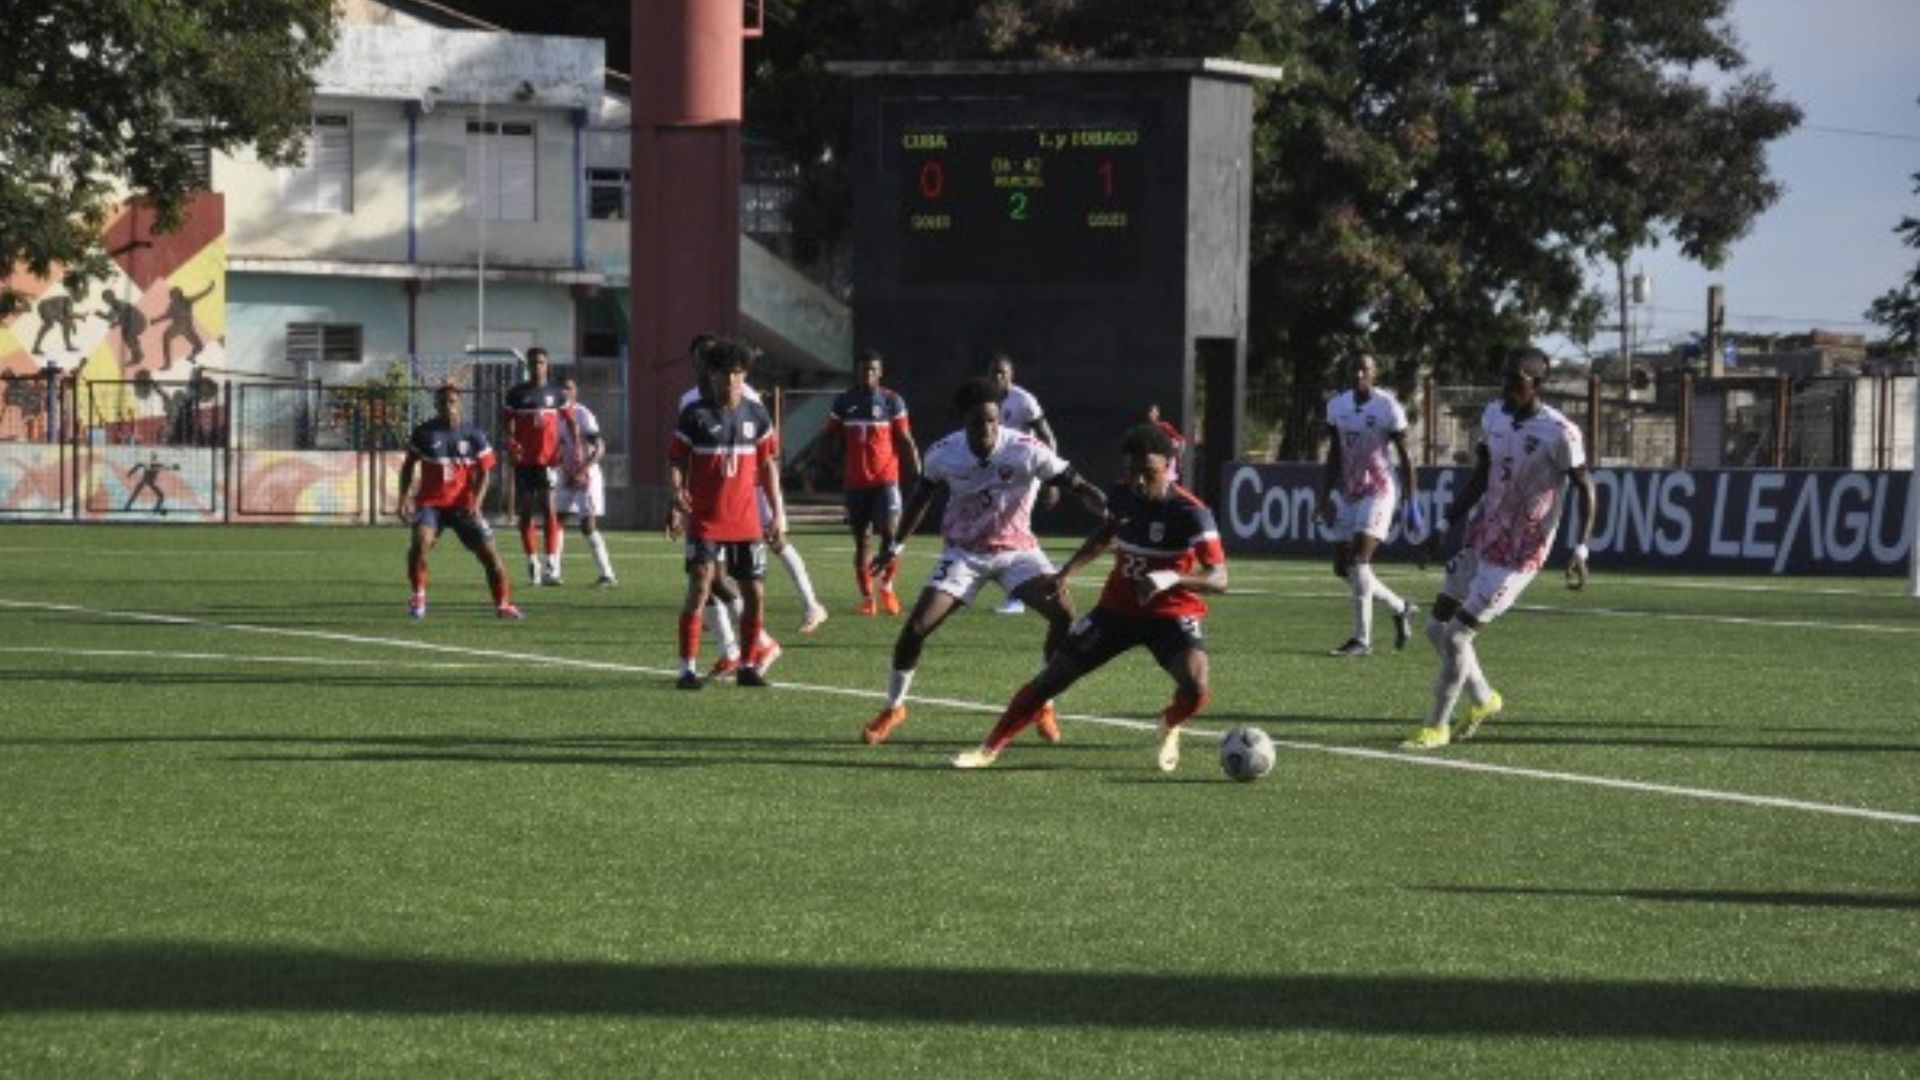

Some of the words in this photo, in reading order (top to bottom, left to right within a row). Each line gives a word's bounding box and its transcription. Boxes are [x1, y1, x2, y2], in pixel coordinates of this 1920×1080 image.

[920, 160, 945, 199] 0
[1097, 159, 1113, 196] 1
[1010, 192, 1028, 220] 2
[1230, 466, 1453, 545] Conaf
[1123, 554, 1147, 580] 22
